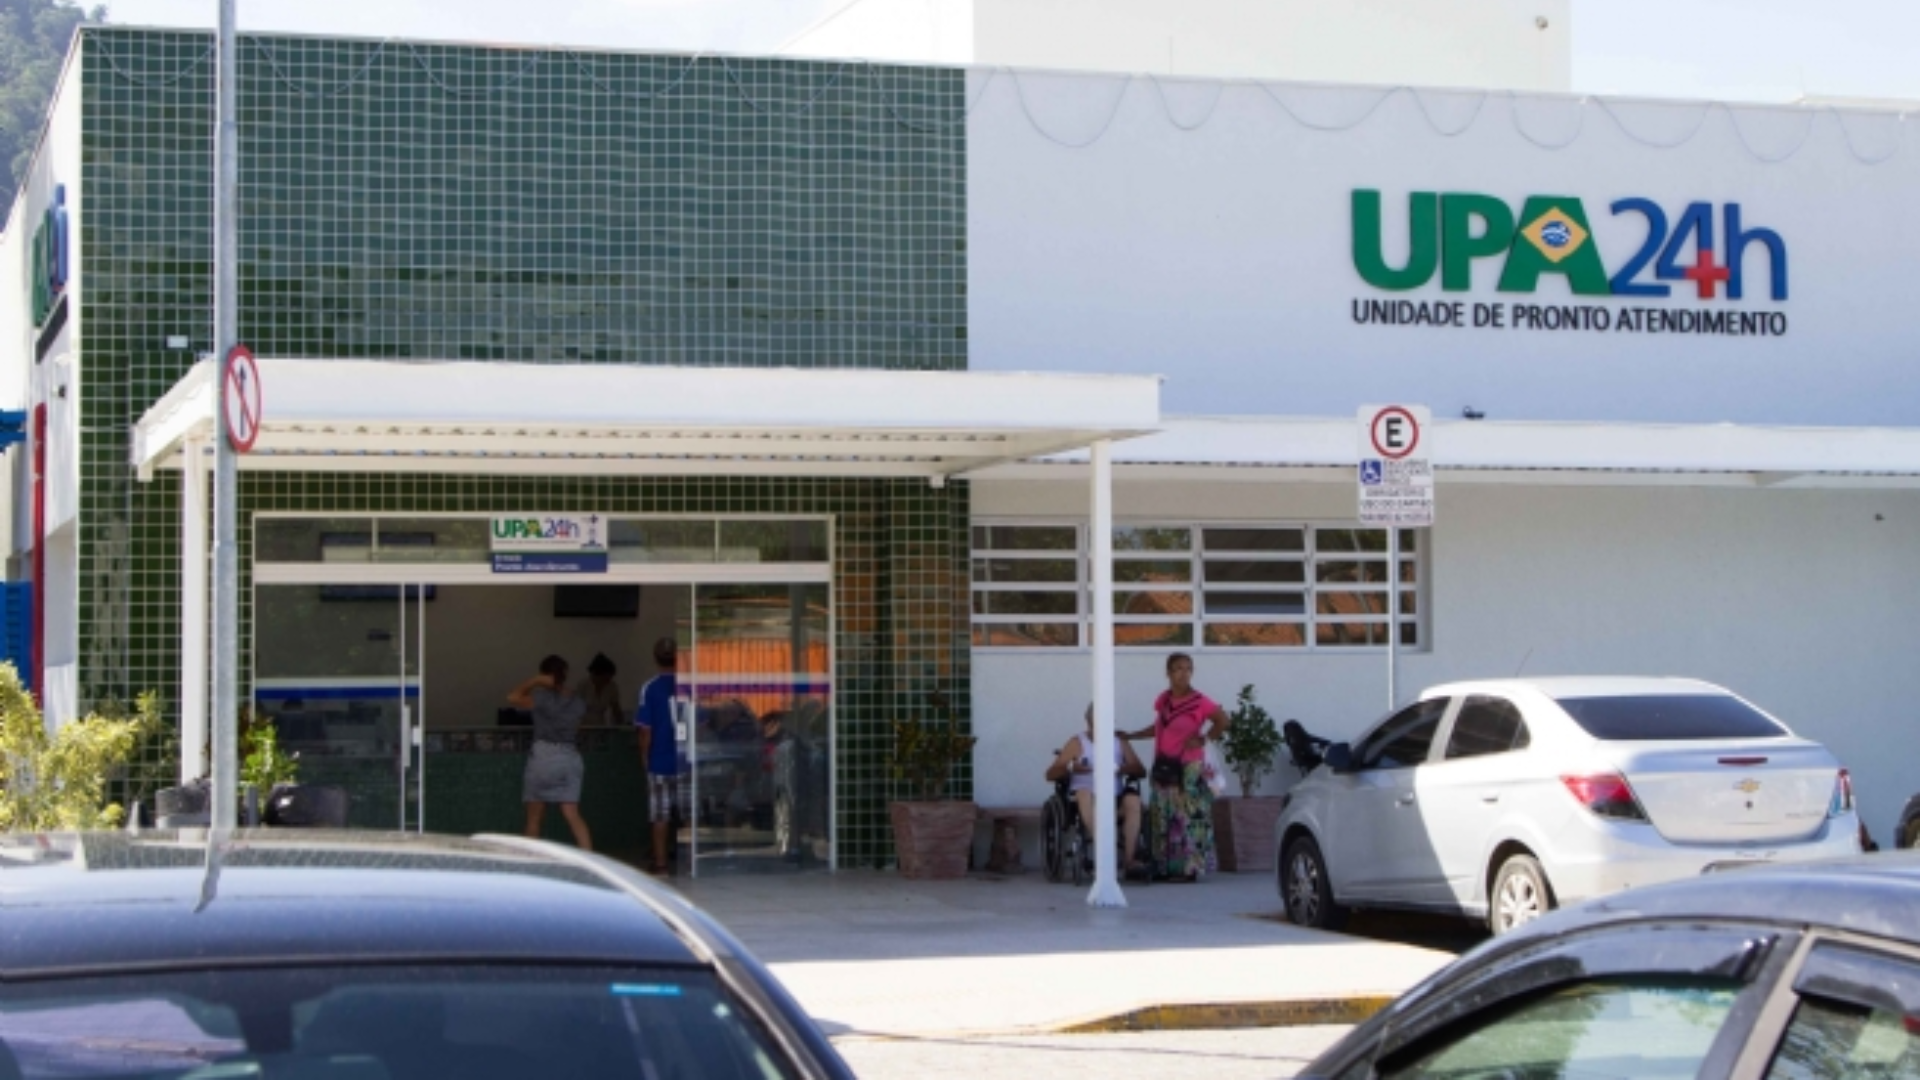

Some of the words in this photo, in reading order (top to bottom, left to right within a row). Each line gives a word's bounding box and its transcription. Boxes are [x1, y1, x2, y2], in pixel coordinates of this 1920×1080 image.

[1351, 298, 1465, 328] UNIDADE
[1473, 302, 1504, 329] DE
[1512, 304, 1610, 332] PRONTO
[1615, 308, 1787, 336] ATENDIMENTO
[1386, 417, 1404, 448] E
